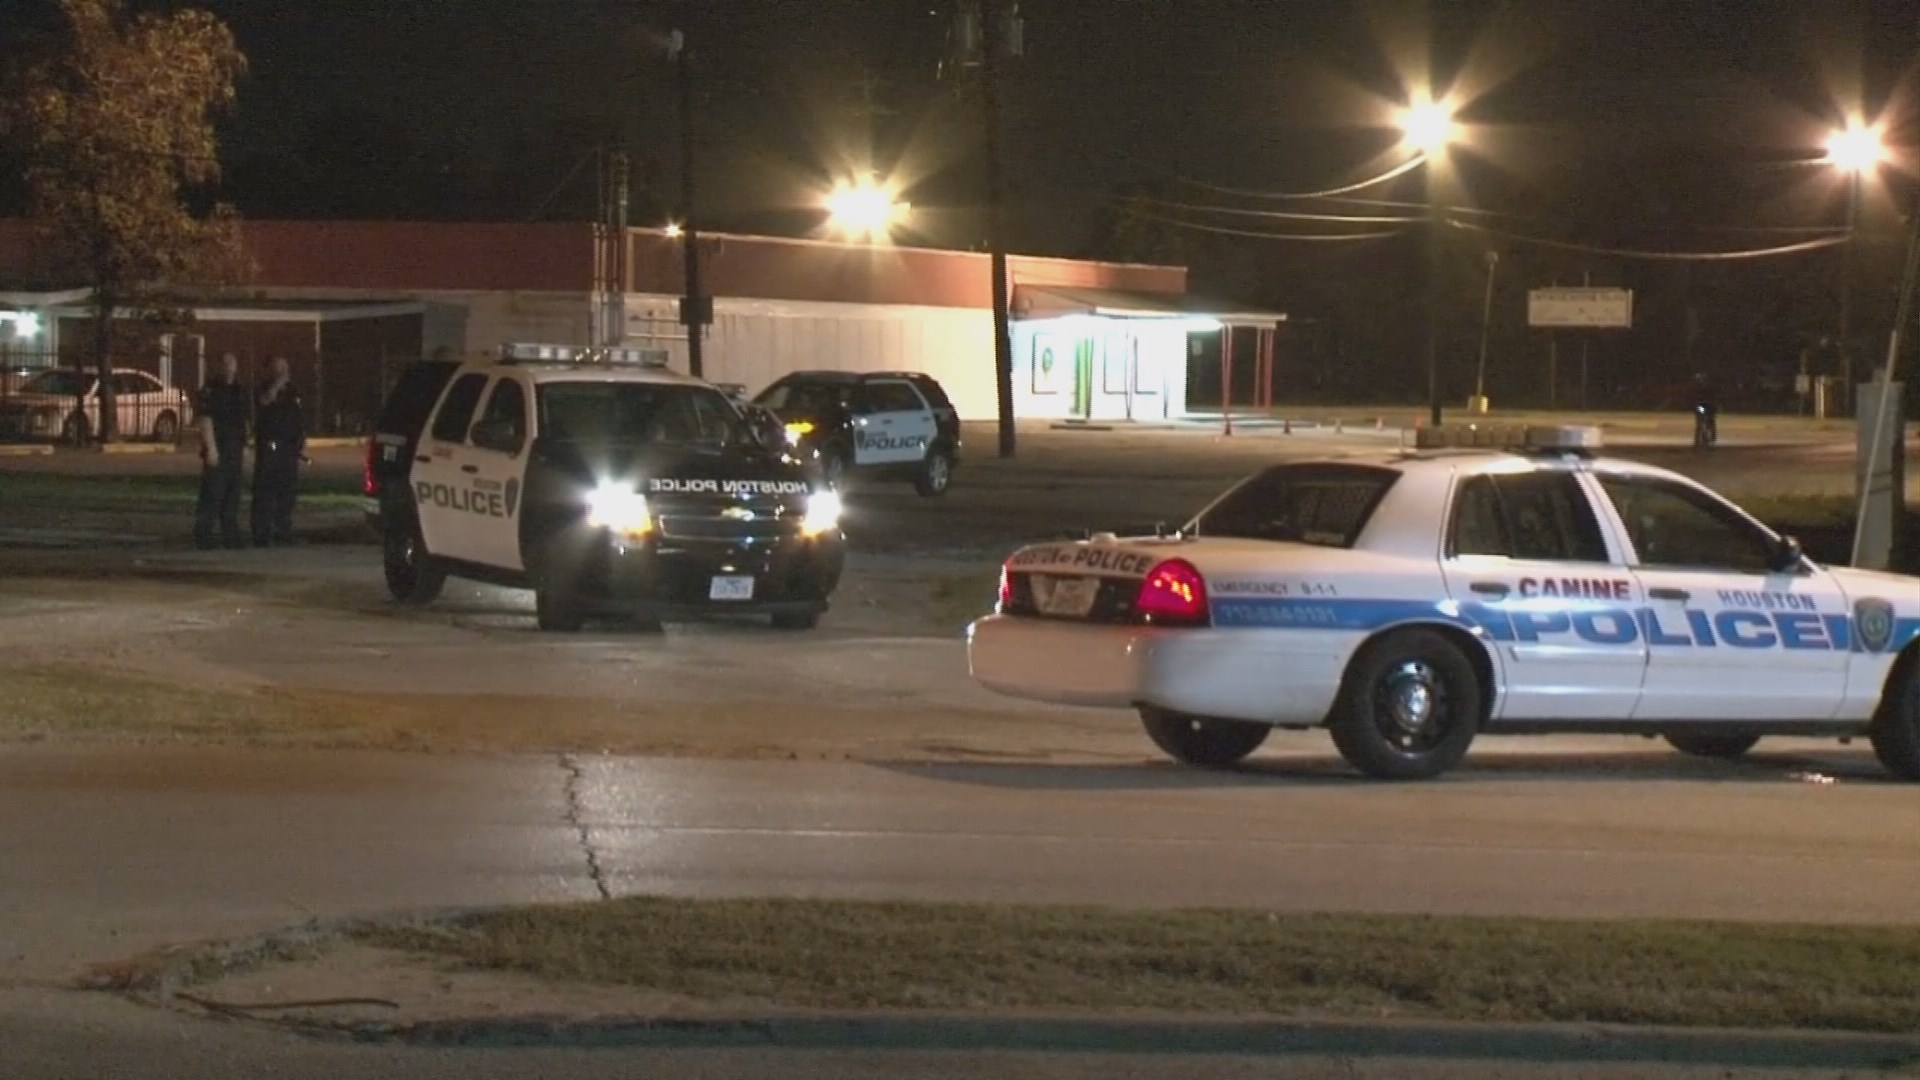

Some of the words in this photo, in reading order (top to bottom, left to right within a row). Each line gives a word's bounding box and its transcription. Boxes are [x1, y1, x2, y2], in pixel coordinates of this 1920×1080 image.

[865, 434, 929, 451] POLICE
[416, 481, 504, 518] POLICE
[1074, 550, 1150, 574] POLICE
[1519, 577, 1630, 600] CANINE
[1717, 589, 1817, 611] HOUSTON
[1511, 609, 1831, 650] POLICE
